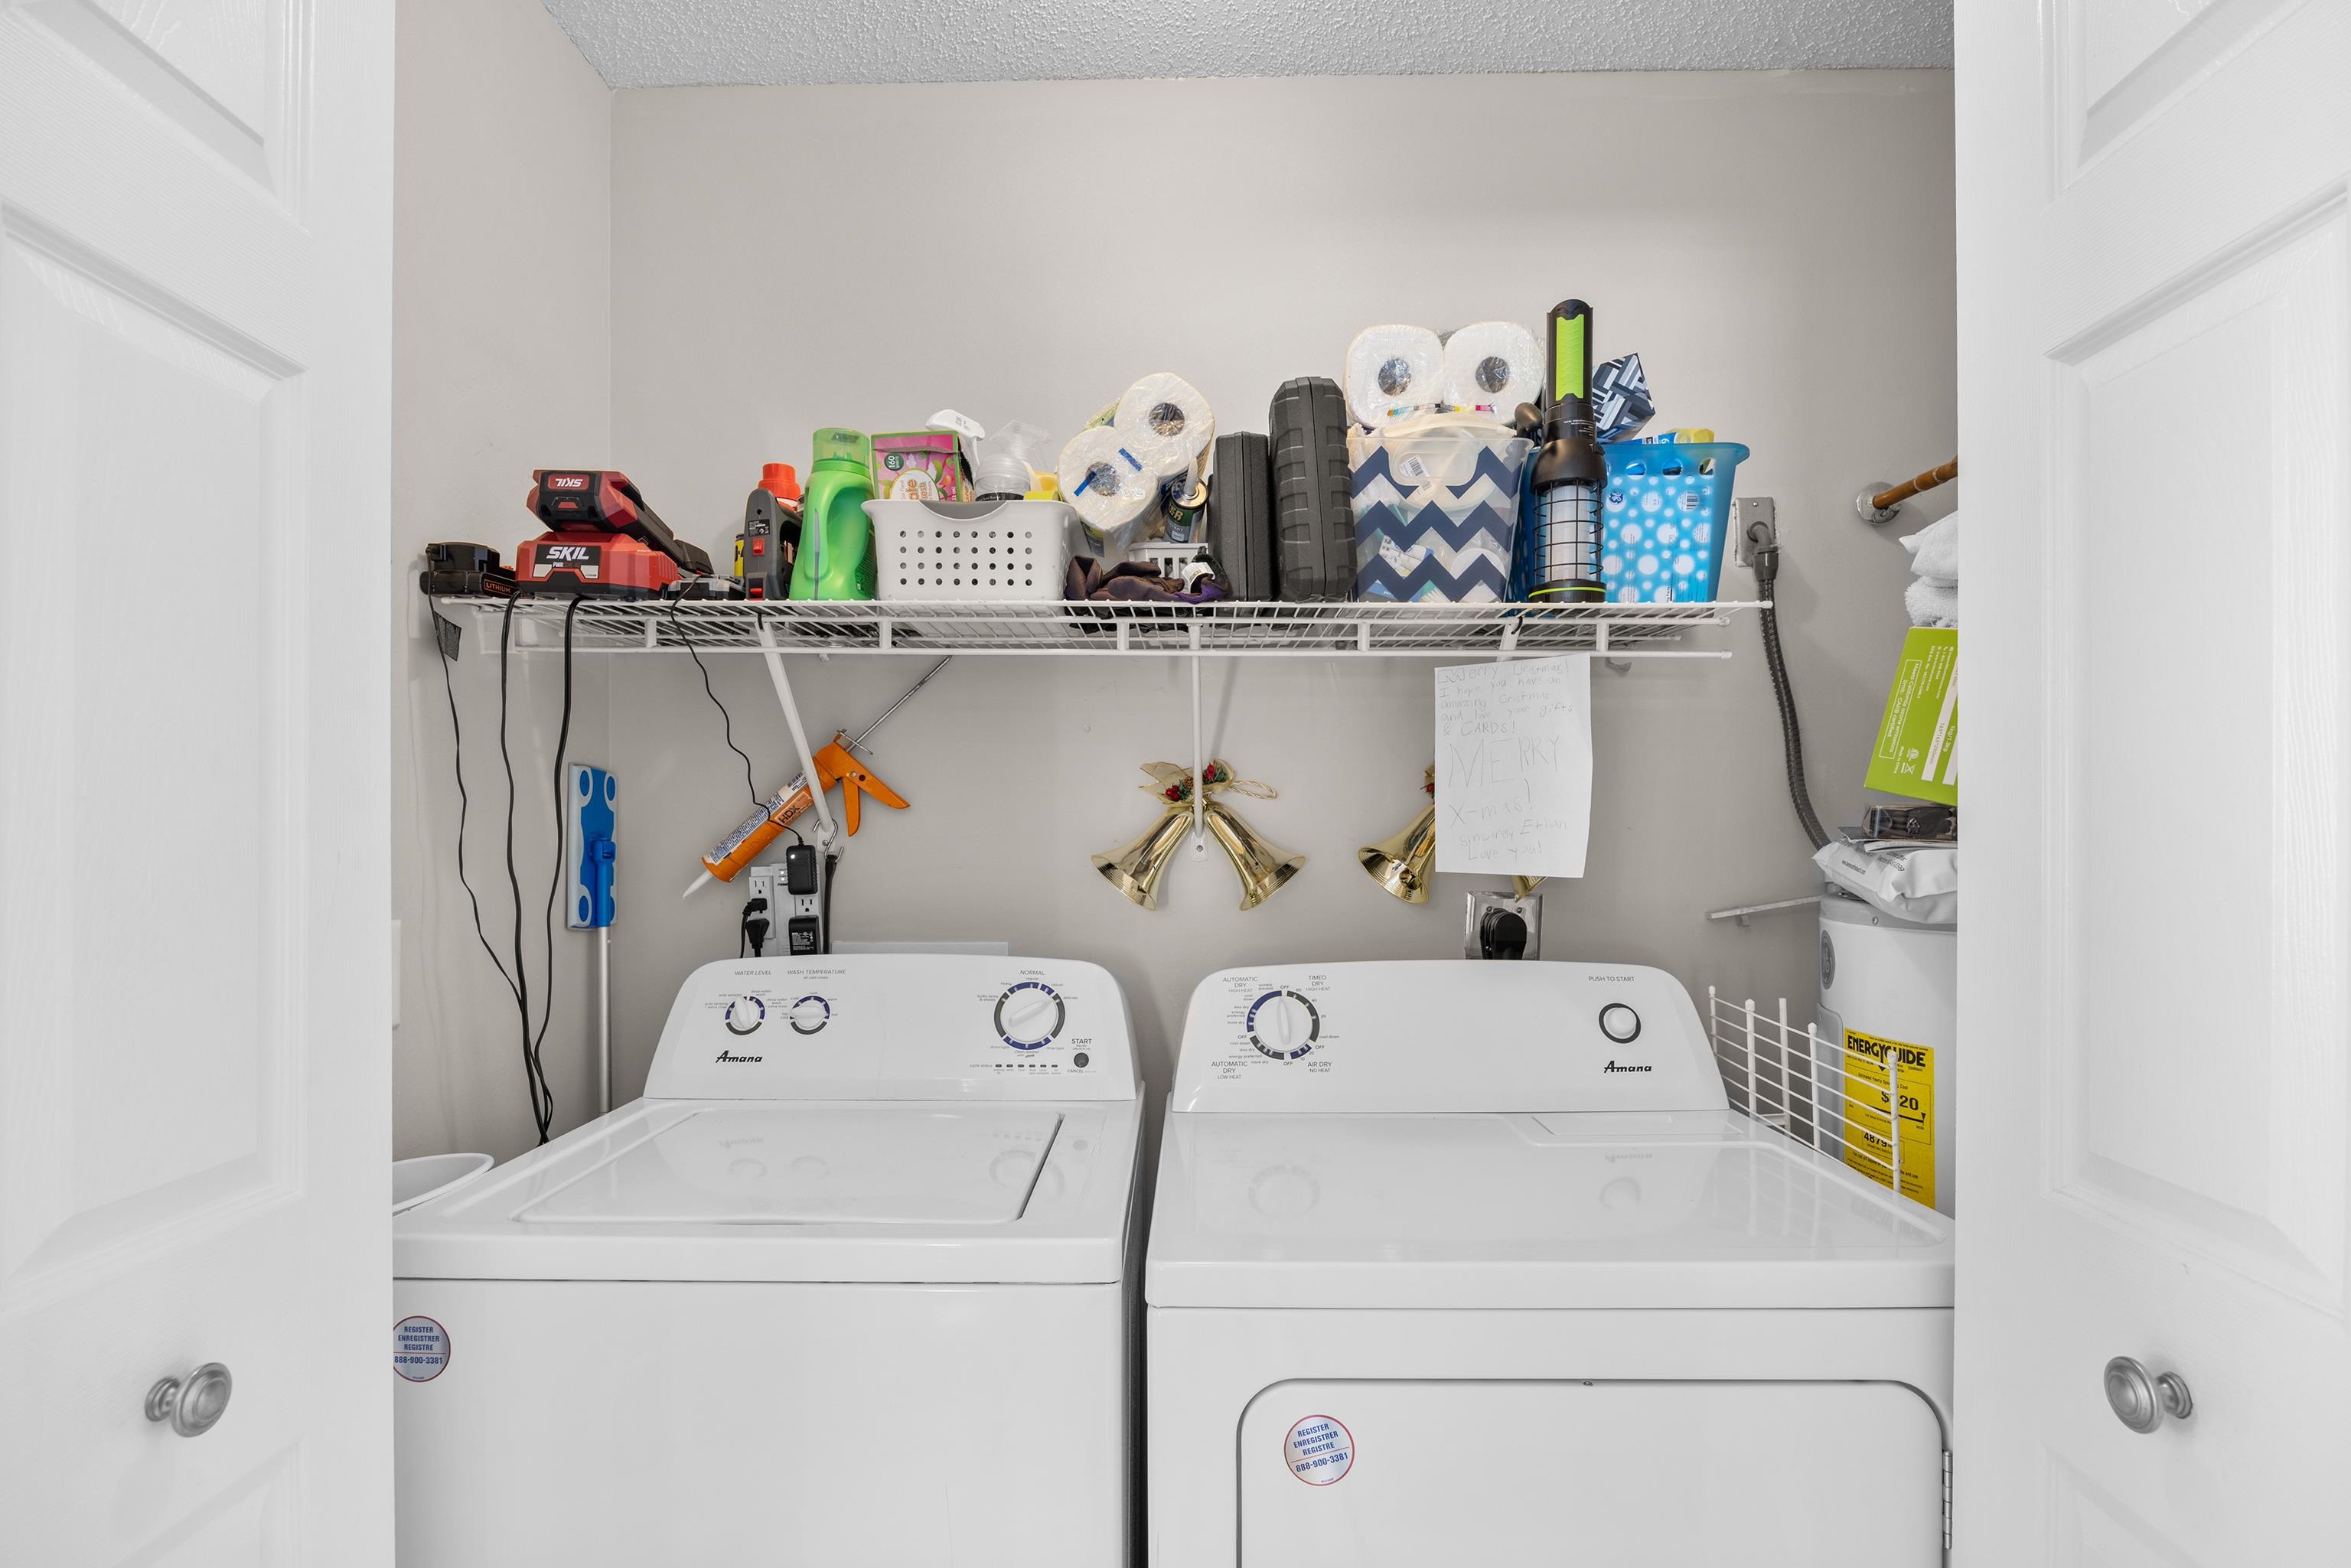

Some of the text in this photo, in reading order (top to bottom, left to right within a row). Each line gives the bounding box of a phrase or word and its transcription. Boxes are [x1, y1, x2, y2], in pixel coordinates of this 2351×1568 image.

[555, 478, 583, 487] SKIL
[907, 479, 918, 500] ate
[546, 546, 589, 561] SKIL
[486, 582, 510, 594] LITHIUM
[1909, 663, 1919, 680] Meets
[1490, 678, 1507, 693] you
[1903, 681, 1914, 706] California
[1441, 699, 1487, 712] amazing
[1442, 710, 1463, 722] and
[1508, 706, 1530, 718] your
[1540, 702, 1573, 718] gifts
[1894, 697, 1903, 714] CARB
[1889, 725, 1900, 753] emissions
[1449, 735, 1560, 788] MERRY
[778, 804, 800, 823] HDX
[1520, 817, 1567, 835] Ethan
[716, 1050, 762, 1063] Amana
[1604, 1061, 1652, 1073] Amana
[1881, 1091, 1919, 1110] $20
[394, 1356, 442, 1364] 888-900-3381
[1297, 1423, 1329, 1438] REGISTER
[1293, 1430, 1339, 1449] ENREGISTRER
[1303, 1442, 1335, 1456] REGISTRE
[1296, 1452, 1348, 1472] 888-900-3381
